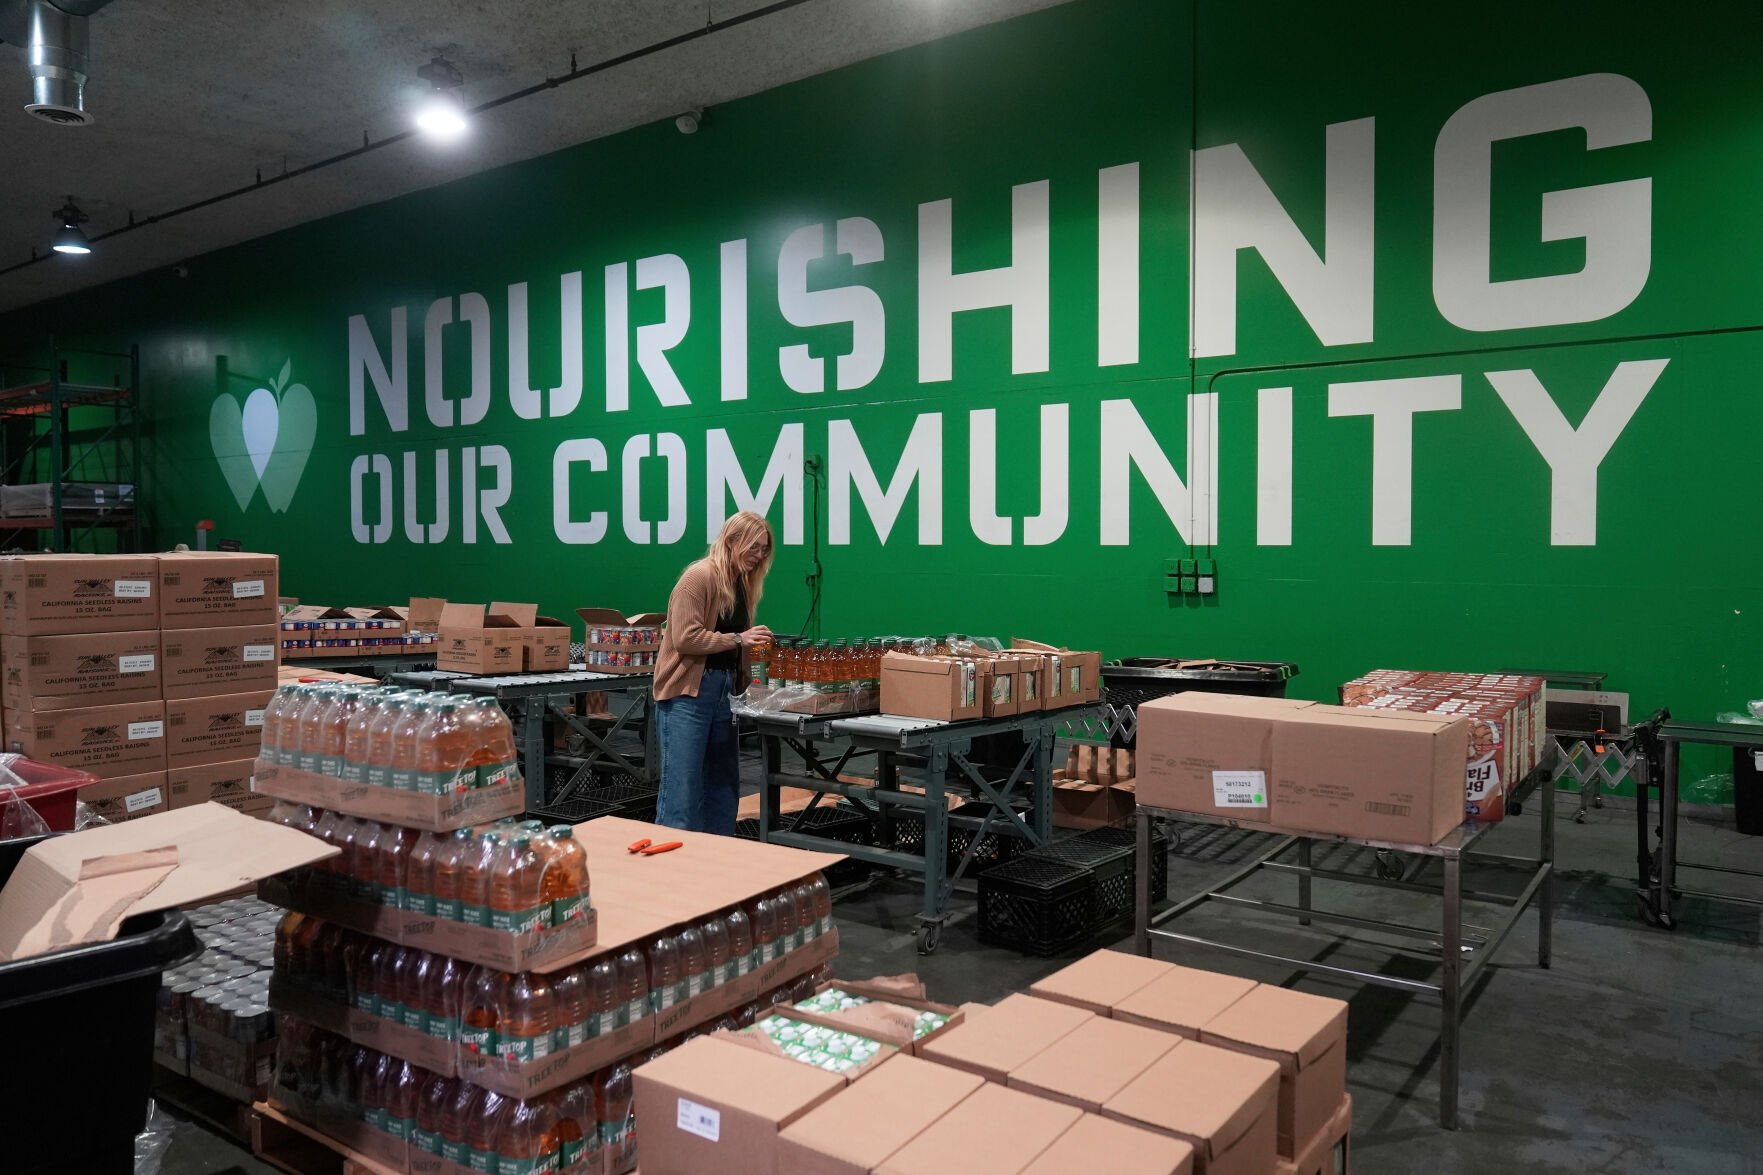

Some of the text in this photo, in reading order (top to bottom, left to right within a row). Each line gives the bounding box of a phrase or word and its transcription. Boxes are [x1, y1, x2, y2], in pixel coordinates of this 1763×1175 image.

[348, 72, 1653, 436] NOURISHING
[350, 358, 1671, 546] OUR COMMUNITY
[178, 666, 213, 674] CALIFORNIA
[46, 676, 86, 685] CALIFORNIA
[89, 673, 119, 682] SEEDLESS
[182, 734, 216, 743] CALIFORNIA
[50, 742, 149, 758] CALIFORNIA SEEDLESS RAISINS
[1467, 765, 1491, 780] Fla
[1466, 781, 1484, 792] Br
